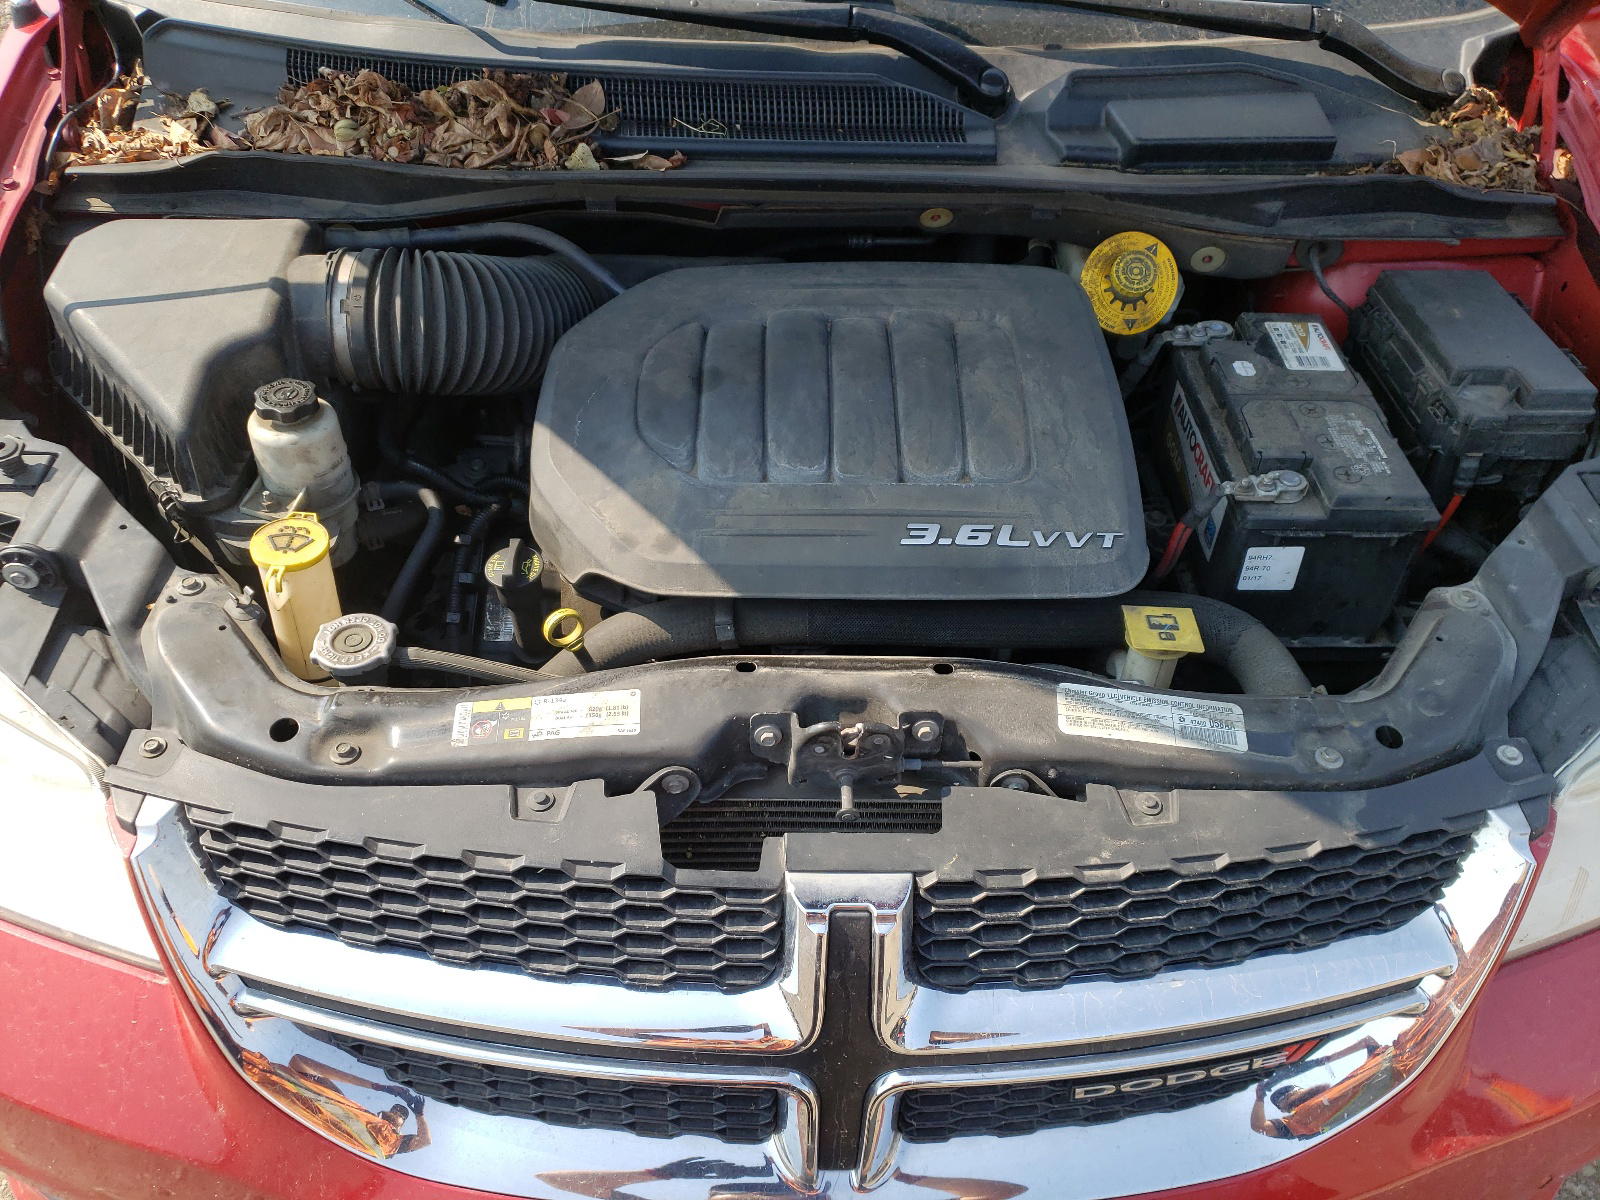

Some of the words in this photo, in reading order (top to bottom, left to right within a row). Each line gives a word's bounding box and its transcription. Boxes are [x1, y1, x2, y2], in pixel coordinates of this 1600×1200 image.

[1143, 696, 1169, 705] EMISSION
[1196, 703, 1233, 713] INFORMATION
[1074, 1051, 1288, 1099] DODGE
